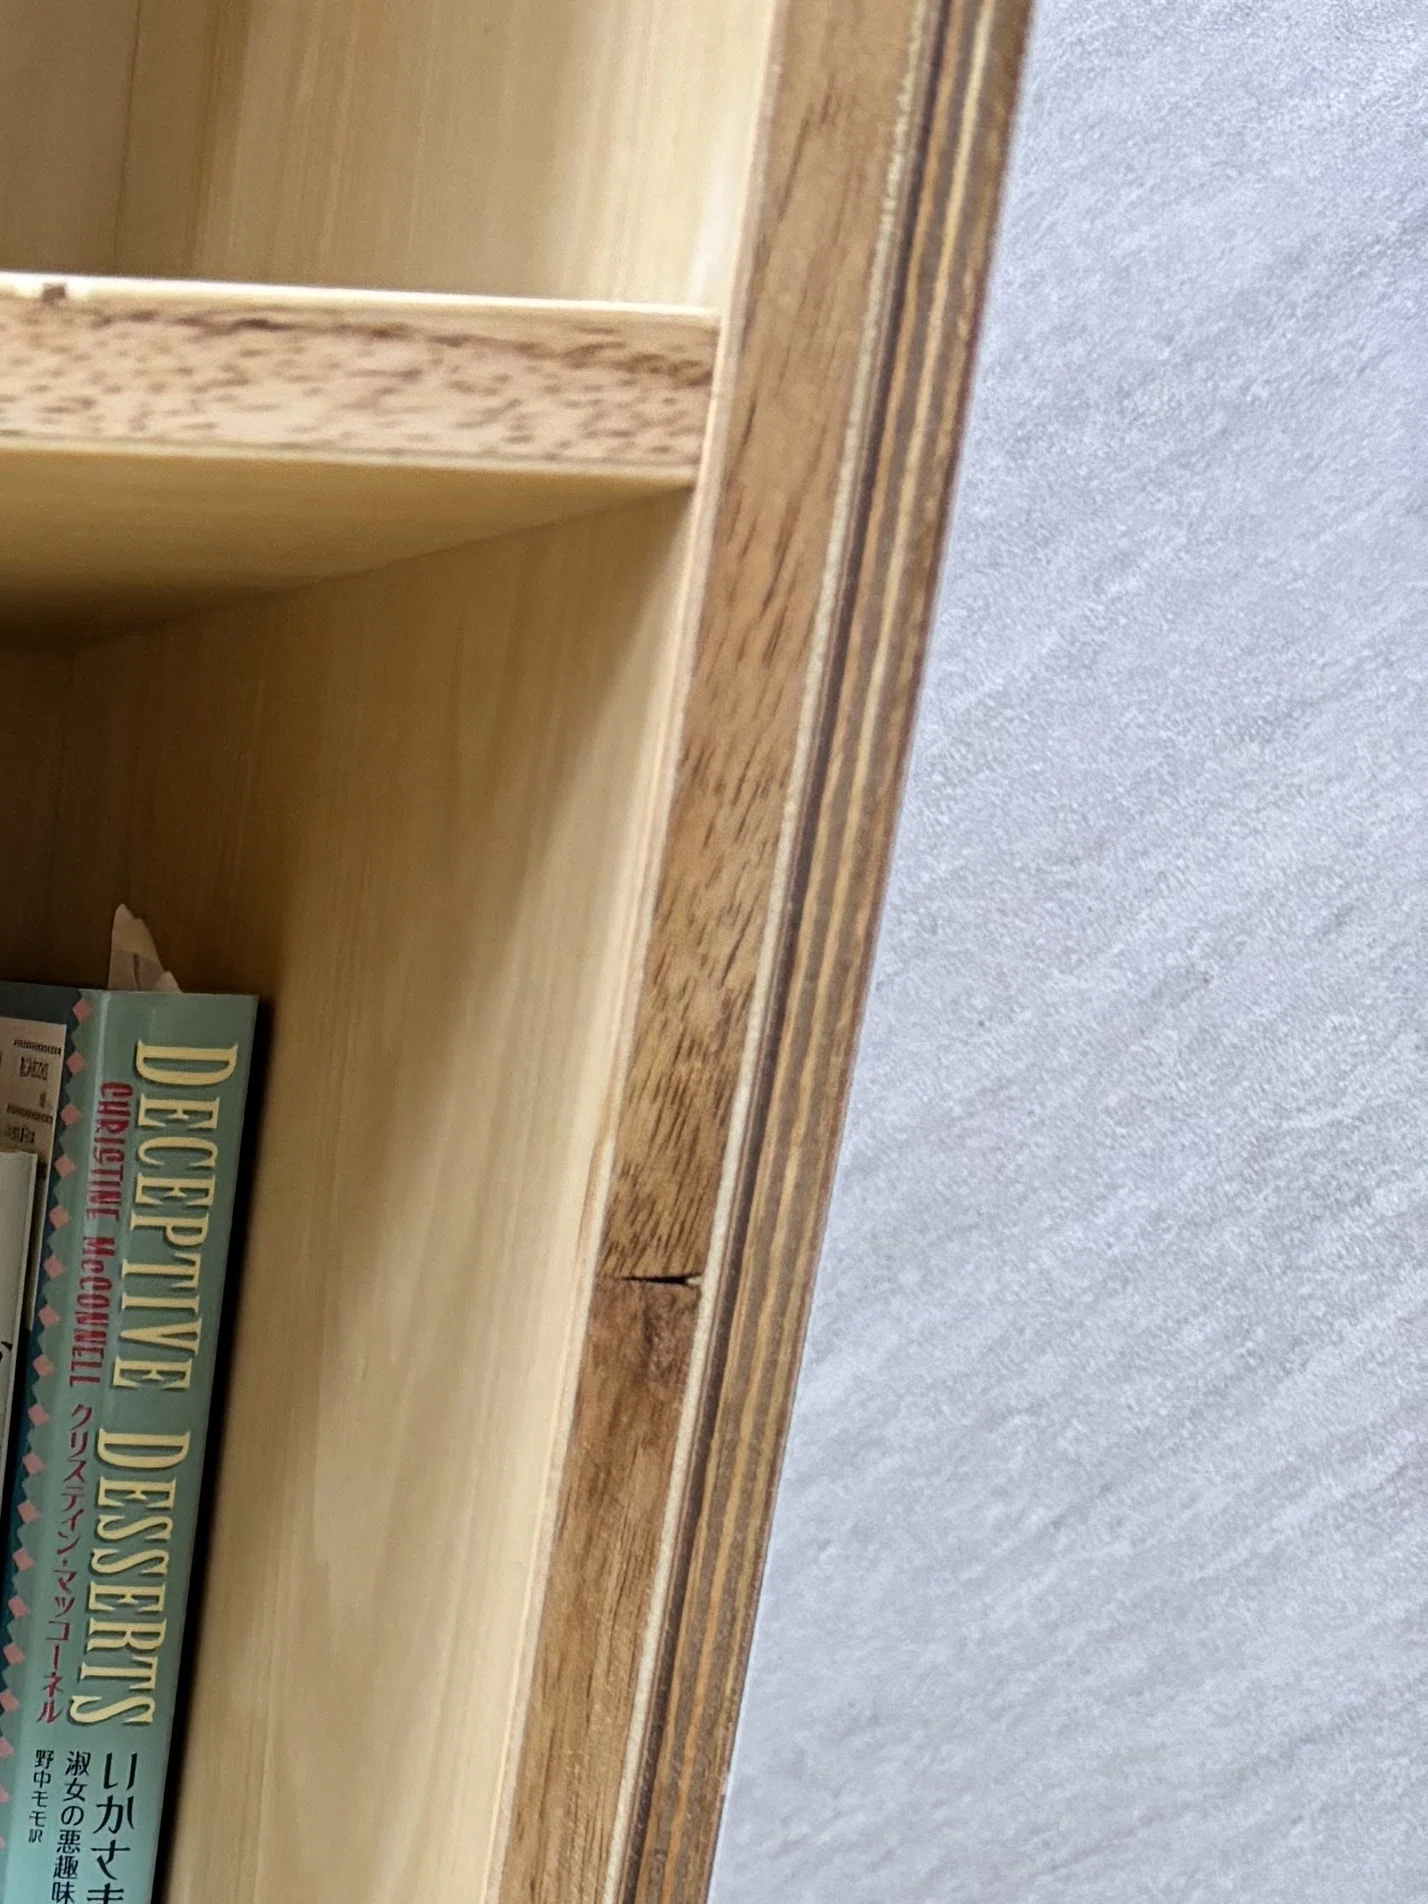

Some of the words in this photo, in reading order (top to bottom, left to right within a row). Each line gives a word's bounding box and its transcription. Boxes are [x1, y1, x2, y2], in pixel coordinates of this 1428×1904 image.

[85, 1080, 135, 1222] CHRISTINE
[111, 1039, 239, 1393] DECEPTIVE
[35, 1402, 93, 1726] クリスティン・マッコーネル
[71, 1428, 191, 1727] DESSERTS
